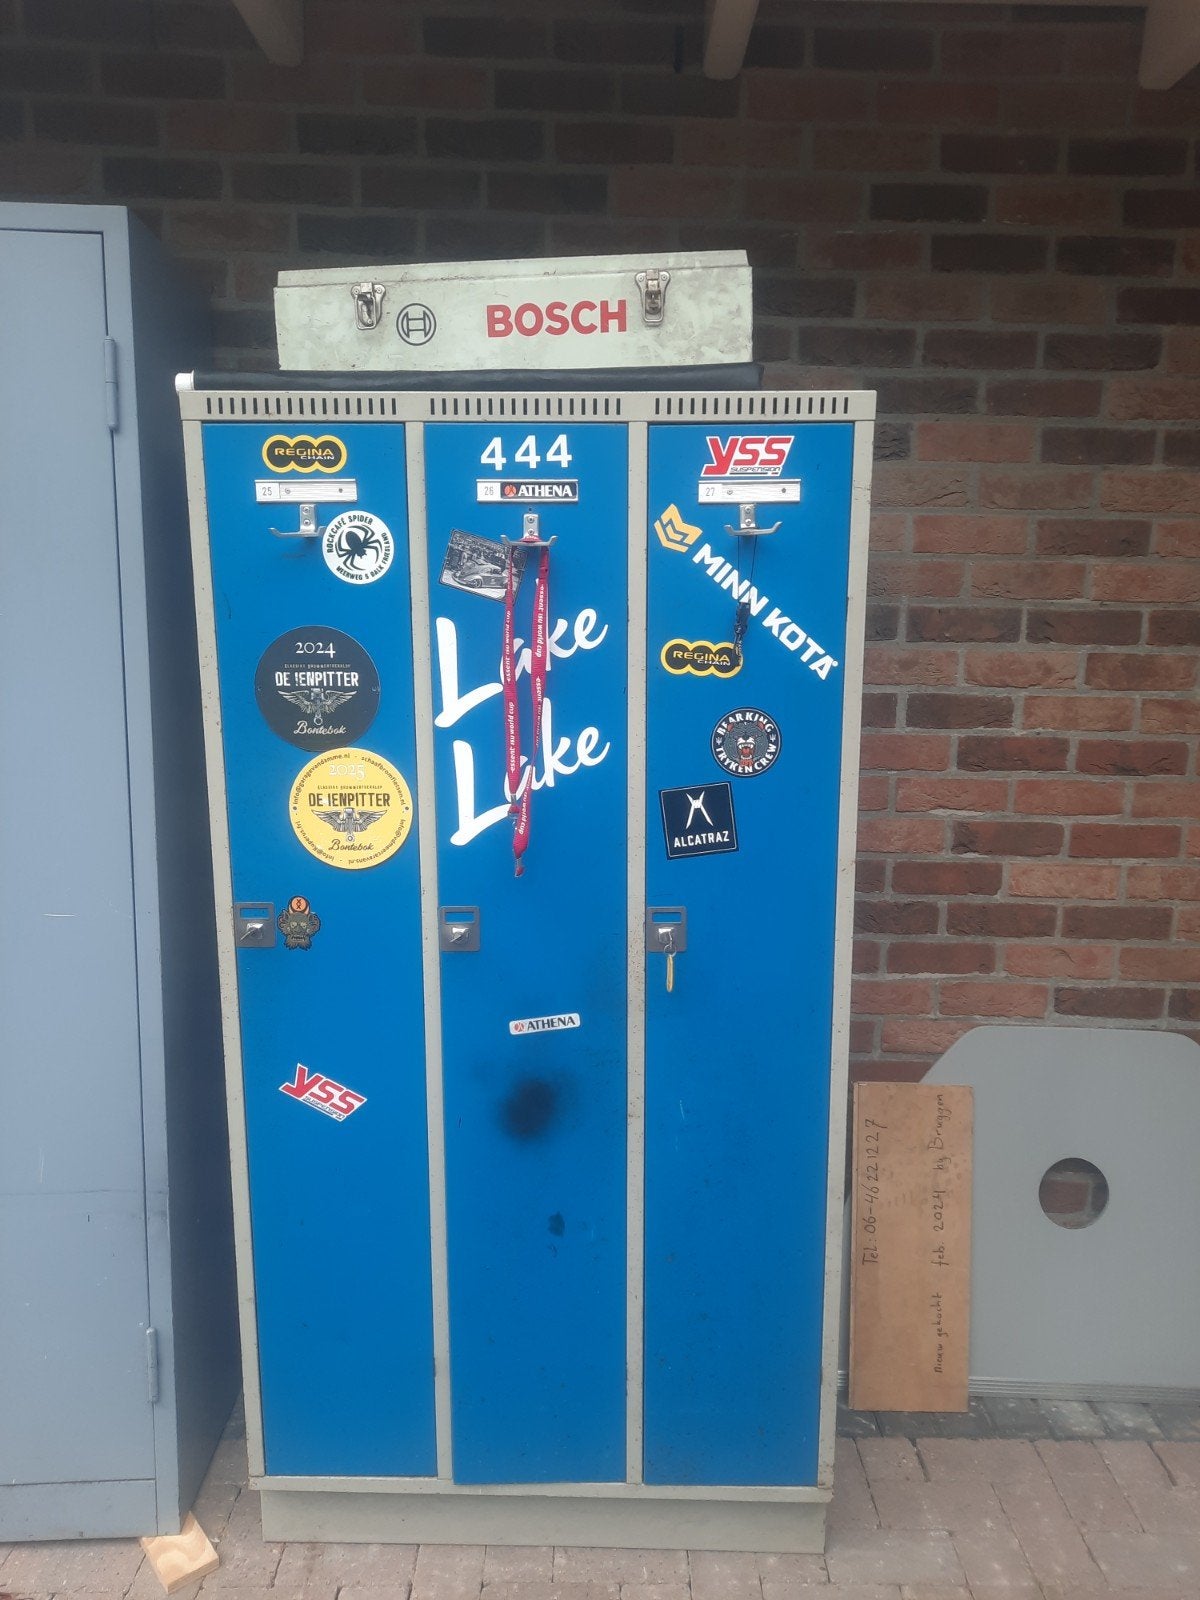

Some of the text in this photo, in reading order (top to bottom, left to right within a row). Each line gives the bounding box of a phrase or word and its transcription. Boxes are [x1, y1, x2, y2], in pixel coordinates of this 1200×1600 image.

[486, 299, 627, 338] BOSCH
[274, 447, 334, 456] REGINA
[702, 436, 793, 476] YSS
[262, 487, 273, 497] 25
[484, 486, 494, 496] 26
[517, 484, 573, 497] ATHENA
[705, 487, 715, 497] 27
[347, 514, 374, 526] SPIDER
[692, 543, 835, 681] MINN KOTA
[536, 624, 544, 643] world
[295, 642, 336, 658] 2024
[672, 650, 730, 661] REGINA
[275, 671, 291, 687] DE
[294, 720, 347, 735] Bontebok
[329, 763, 366, 781] 2025
[308, 793, 391, 807] DE IENPITTER
[328, 838, 374, 851] Bontebok
[673, 830, 730, 848] ALCATRAZ
[527, 1016, 576, 1031] ATHENA
[281, 1065, 365, 1116] YSS
[933, 1190, 946, 1231] 2024
[930, 1292, 949, 1337] gekocht
